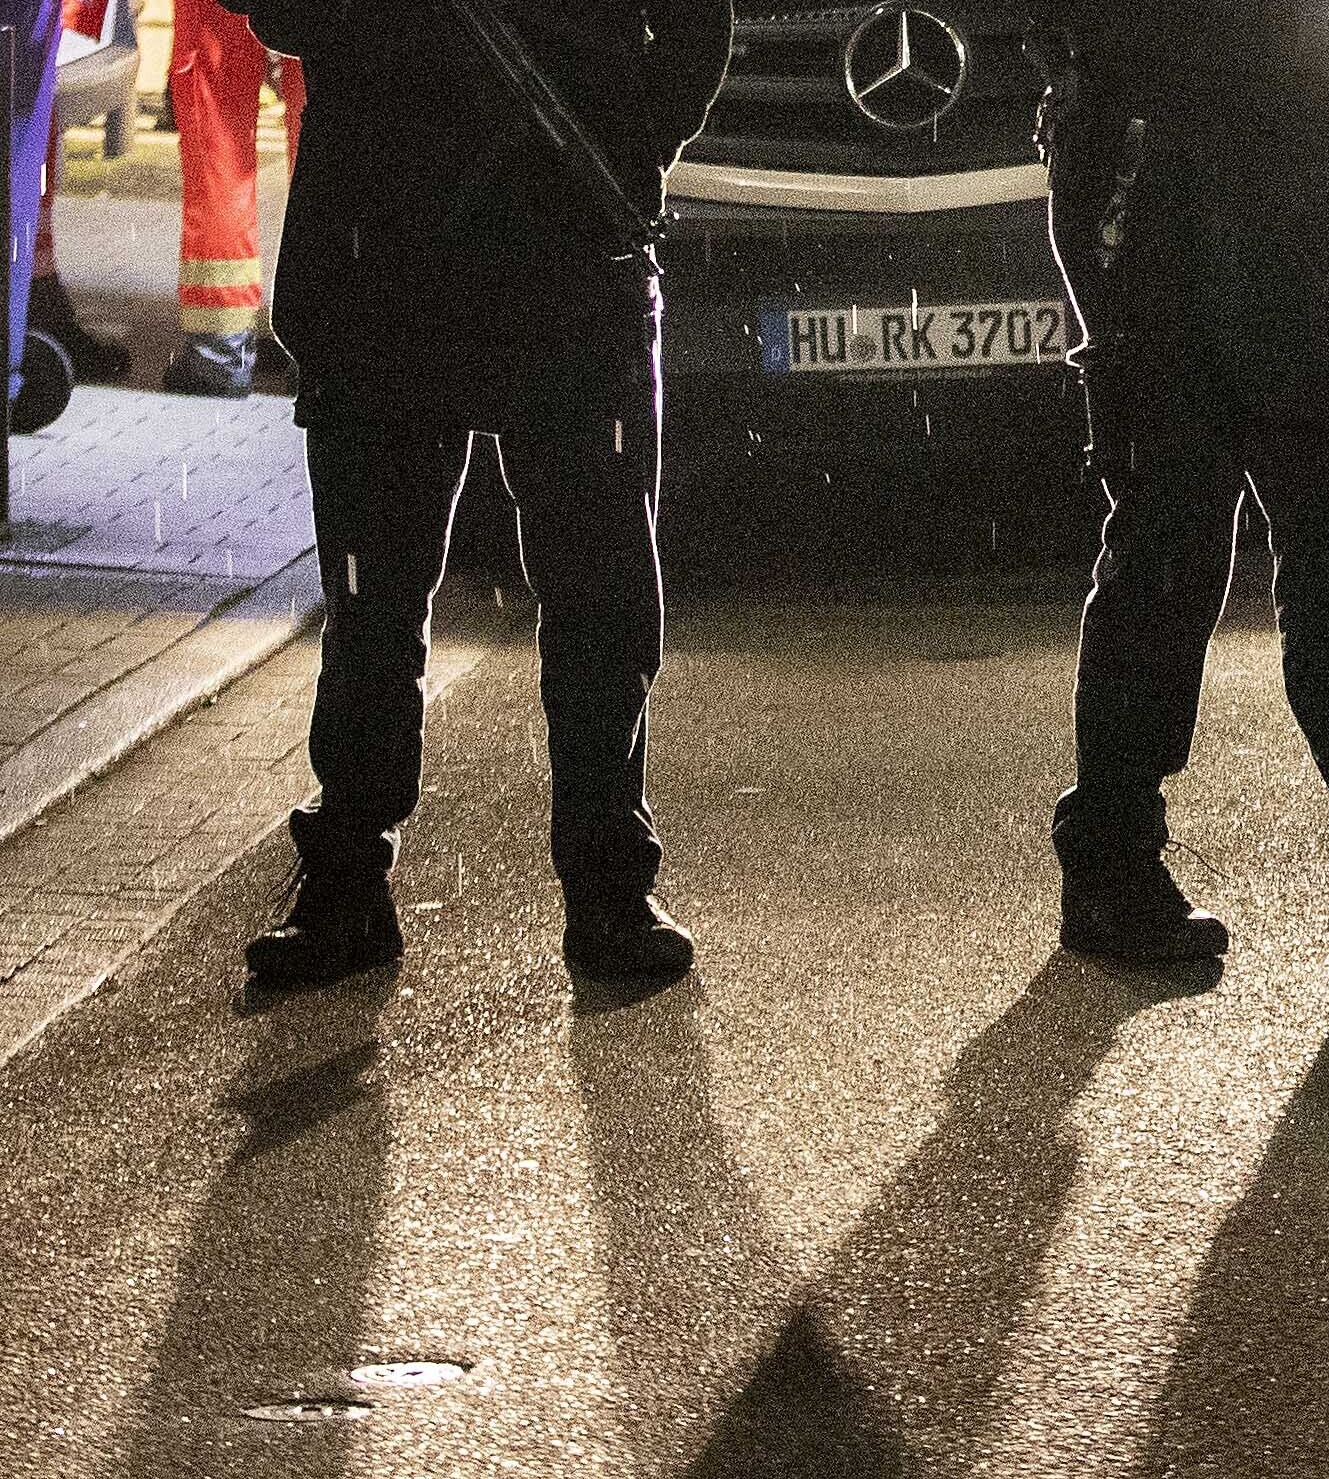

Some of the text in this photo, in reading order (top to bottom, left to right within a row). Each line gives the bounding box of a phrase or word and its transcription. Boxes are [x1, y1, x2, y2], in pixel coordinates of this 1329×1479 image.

[791, 316, 847, 363] HU
[881, 313, 936, 361] RK
[950, 308, 1062, 360] 3702
